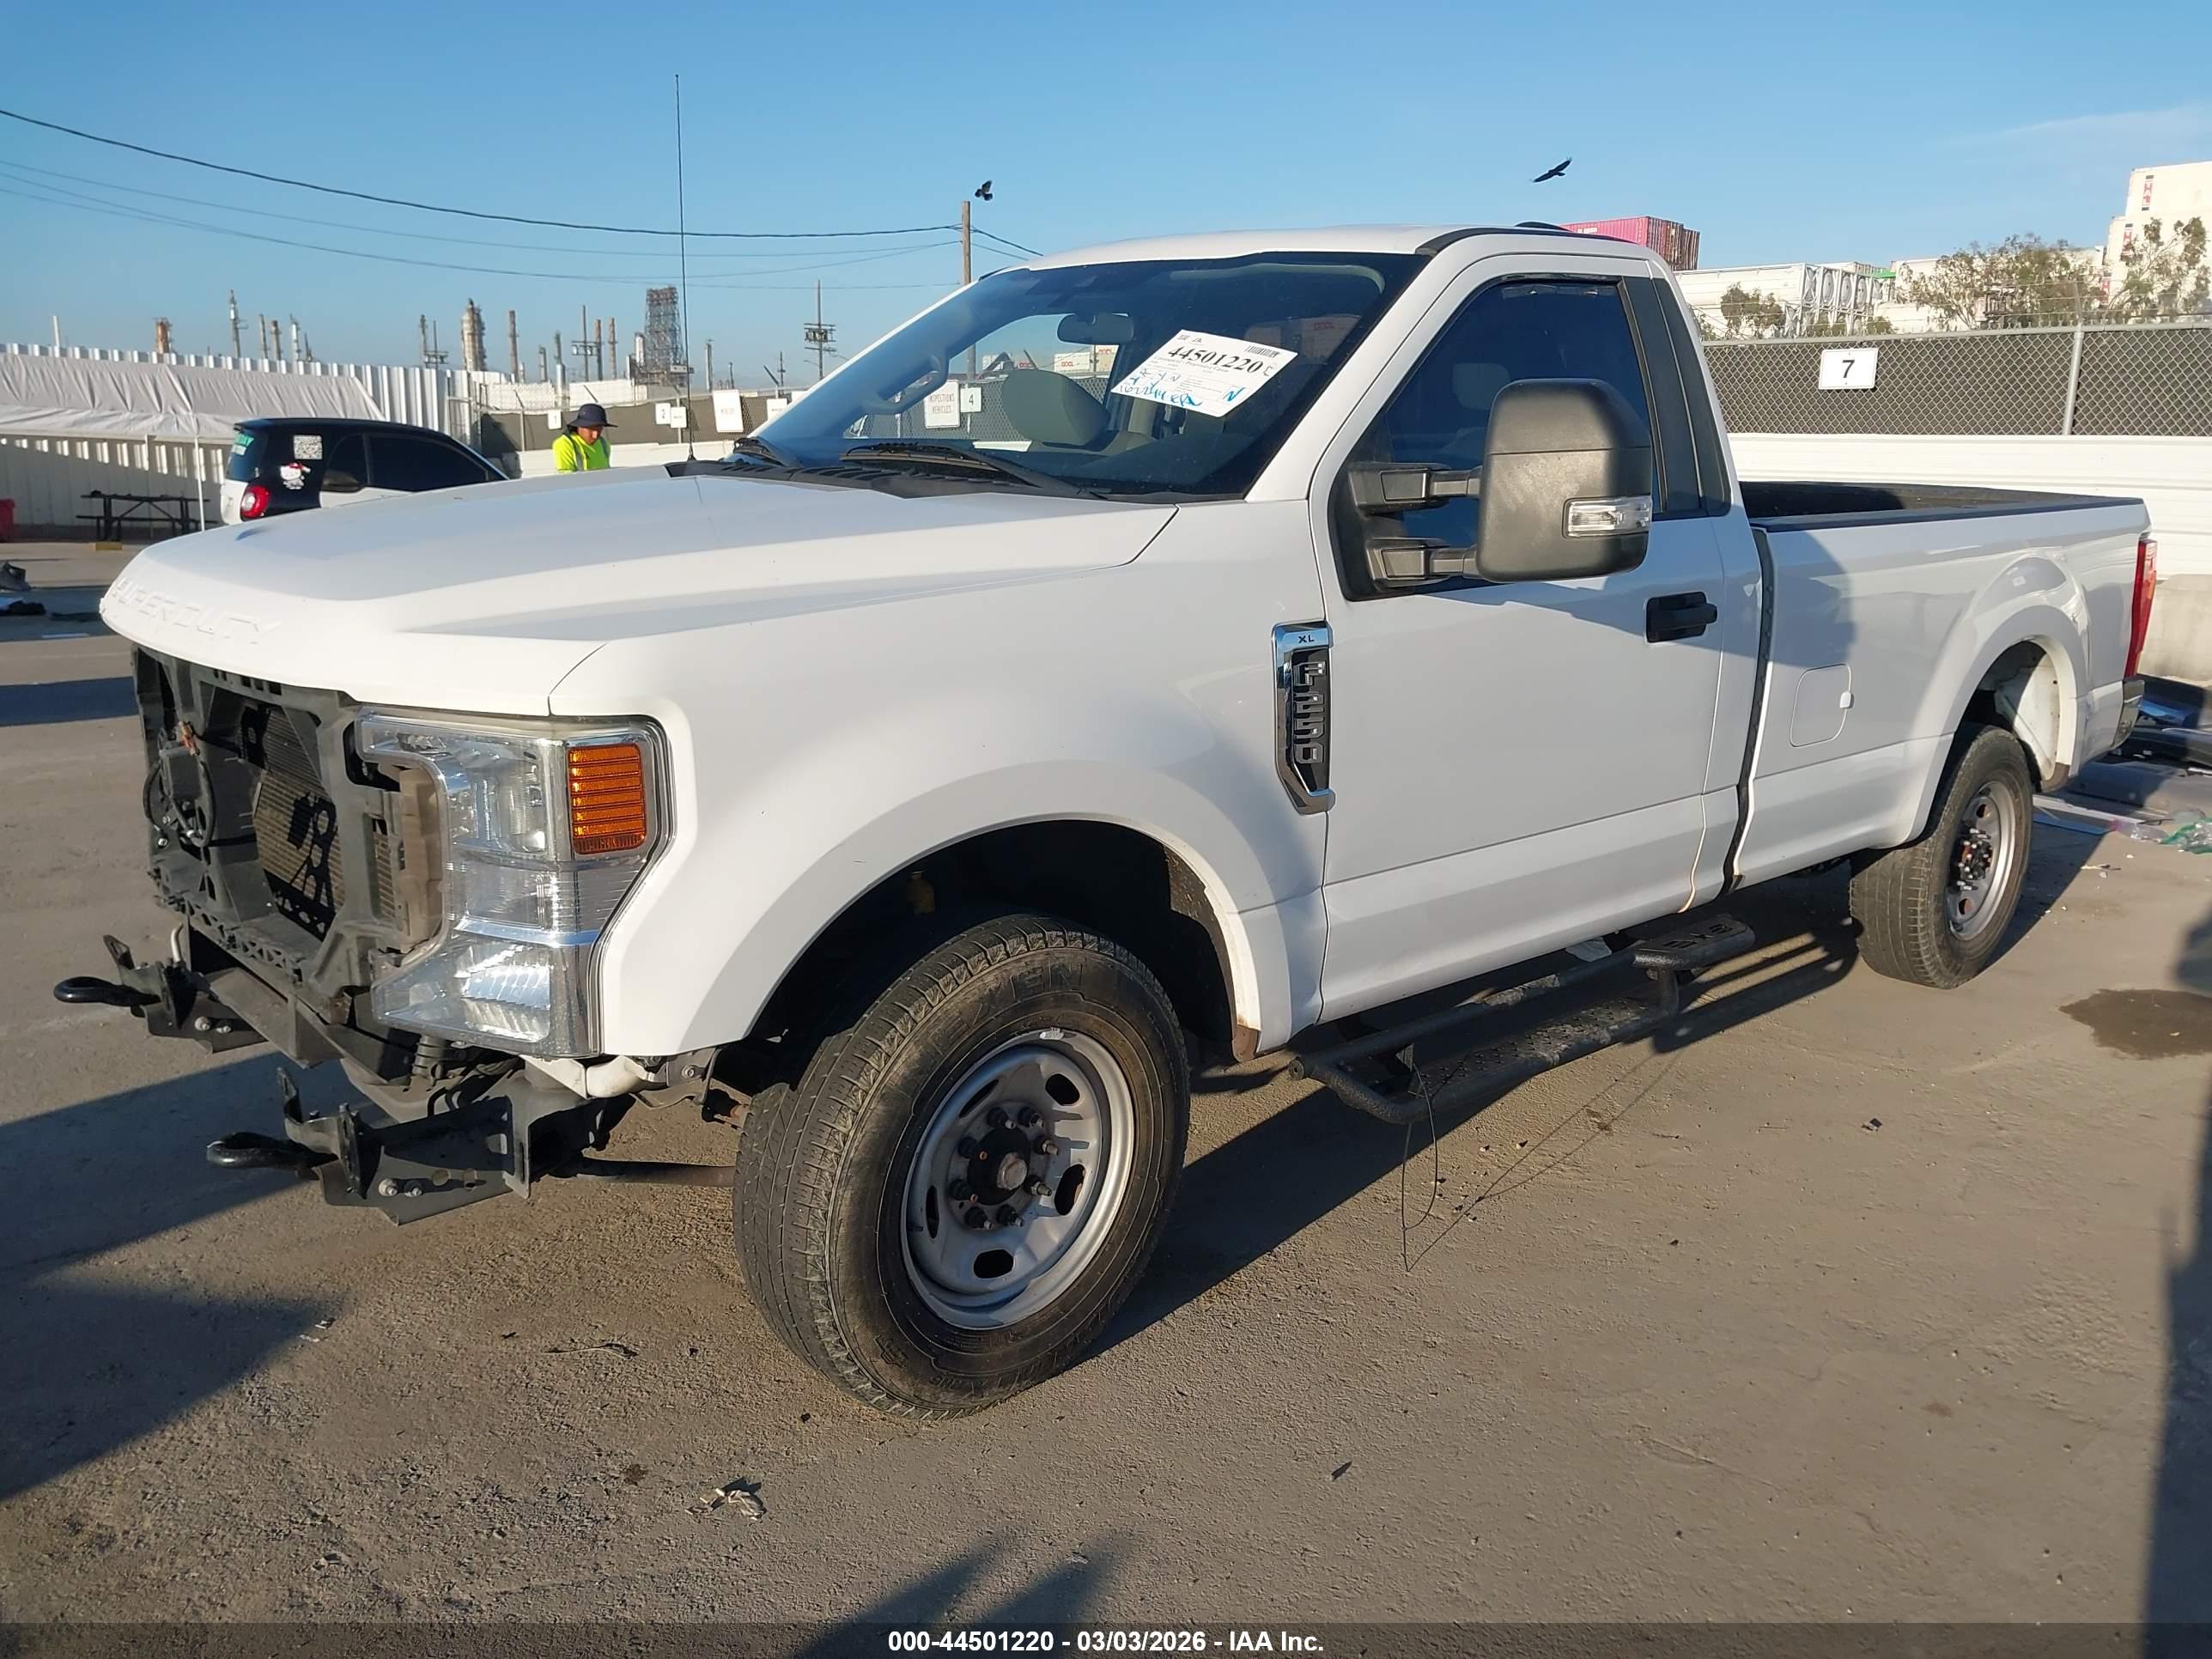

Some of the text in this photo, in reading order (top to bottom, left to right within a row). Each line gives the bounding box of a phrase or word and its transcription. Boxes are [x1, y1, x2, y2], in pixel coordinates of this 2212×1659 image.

[1168, 346, 1264, 374] 44501220
[1842, 359, 1855, 379] 7
[969, 394, 974, 406] 4
[1297, 635, 1315, 643] XL
